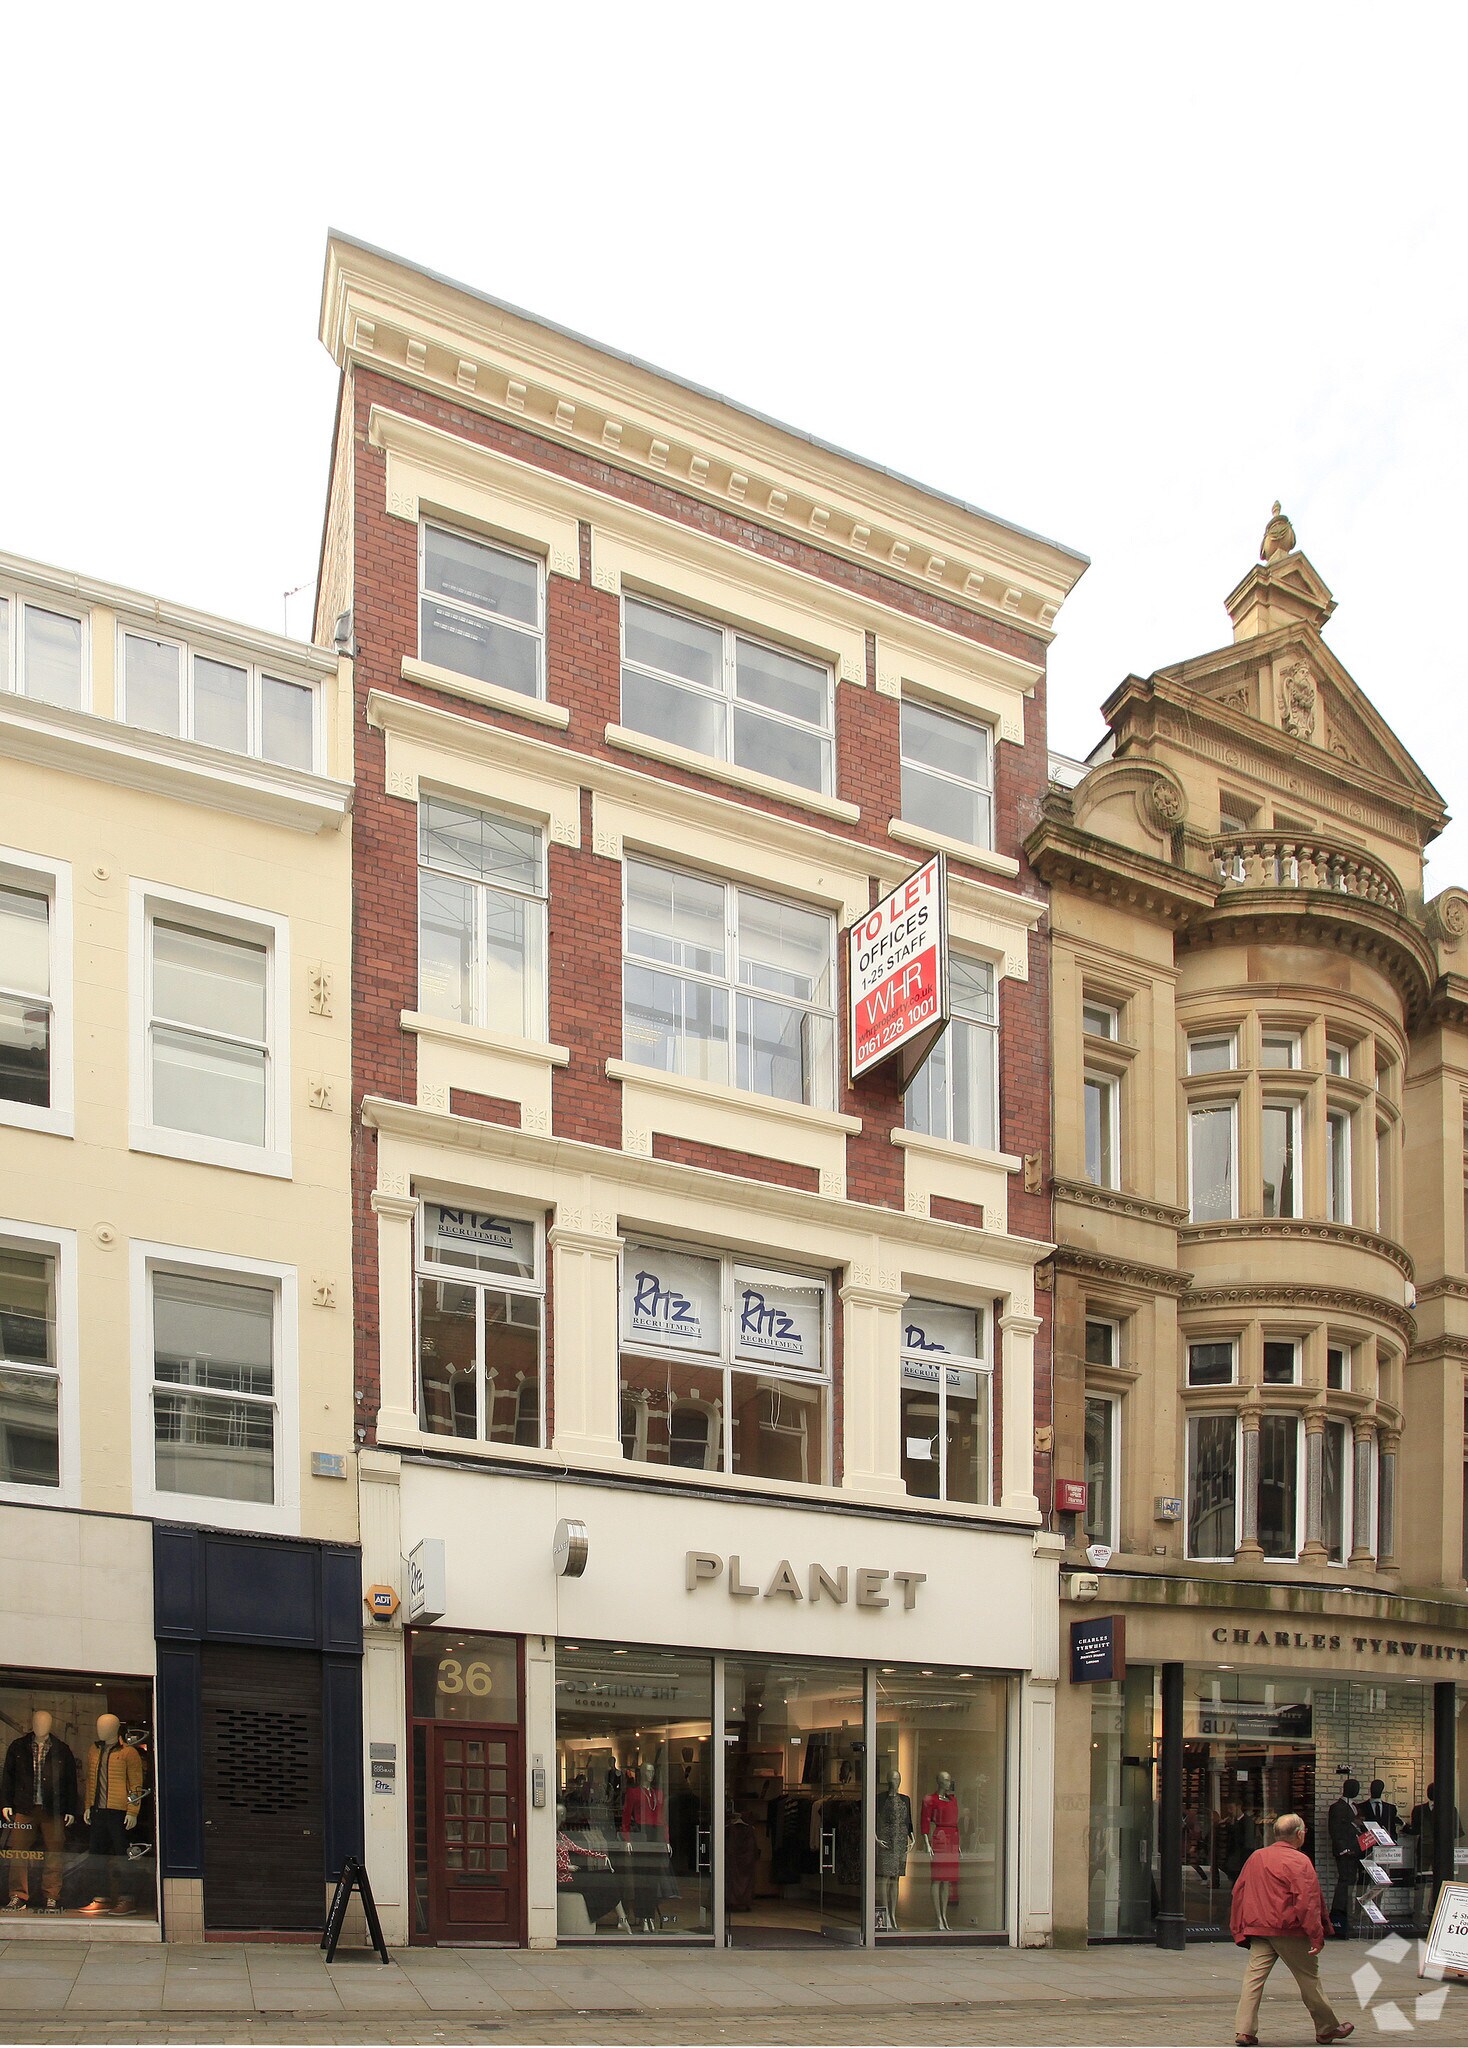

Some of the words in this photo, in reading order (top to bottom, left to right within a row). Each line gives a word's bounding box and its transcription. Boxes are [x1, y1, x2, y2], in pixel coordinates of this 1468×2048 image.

[853, 911, 883, 952] TO
[889, 863, 936, 924] LET
[859, 905, 929, 972] OFFICES
[861, 963, 884, 991] 1-25
[886, 930, 927, 971] STAFF
[865, 962, 923, 1025] WHR
[857, 1033, 881, 1062] 0161
[882, 1016, 905, 1045] 228
[907, 995, 935, 1025] 1001
[859, 984, 934, 1043] whrproperty.co.uk
[438, 1224, 514, 1244] RECRUITMENT
[633, 1317, 703, 1334] RECRUITMENT
[740, 1334, 804, 1351] RECRUITMENT
[904, 1366, 961, 1381] RECRUITENT
[685, 1550, 927, 1610] PLANET
[374, 1595, 392, 1606] ADT
[1076, 1641, 1110, 1652] TYRWHITT
[1078, 1635, 1108, 1645] CHARLES
[1212, 1627, 1341, 1650] CHARLES
[1353, 1636, 1468, 1662] TYRWHITT
[437, 1658, 493, 1696] 36
[0, 1849, 44, 1860] NSTORE
